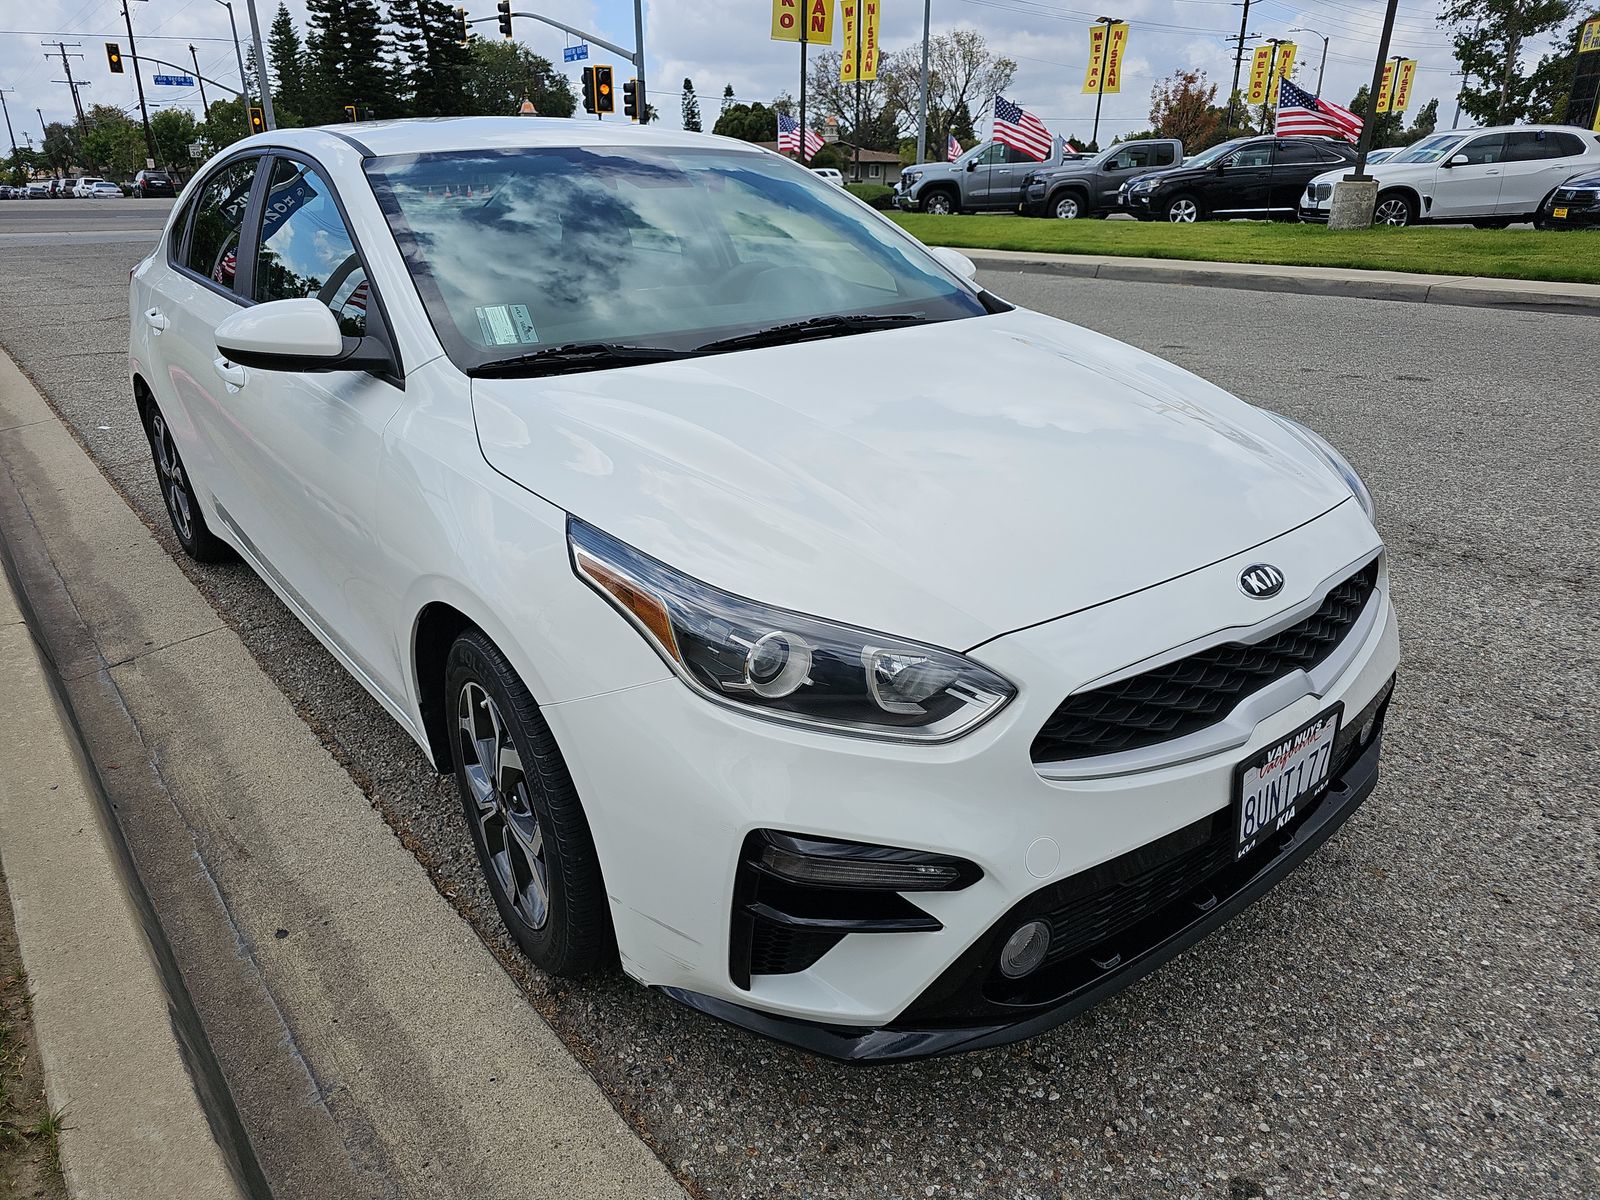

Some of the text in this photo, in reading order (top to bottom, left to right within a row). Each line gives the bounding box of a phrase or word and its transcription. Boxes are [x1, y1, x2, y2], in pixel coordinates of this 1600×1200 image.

[844, 6, 854, 73] METRO
[865, 3, 876, 72] NISSAN
[1088, 31, 1103, 88] METRO
[1107, 31, 1123, 87] NISSAN
[1252, 51, 1268, 98] METRO
[1378, 67, 1392, 107] METRO
[1396, 65, 1412, 106] NISSAN
[1242, 566, 1283, 593] KIA
[1267, 719, 1323, 762] VAN NUYS
[1243, 740, 1331, 839] 8UNT177
[1276, 805, 1296, 831] KIA
